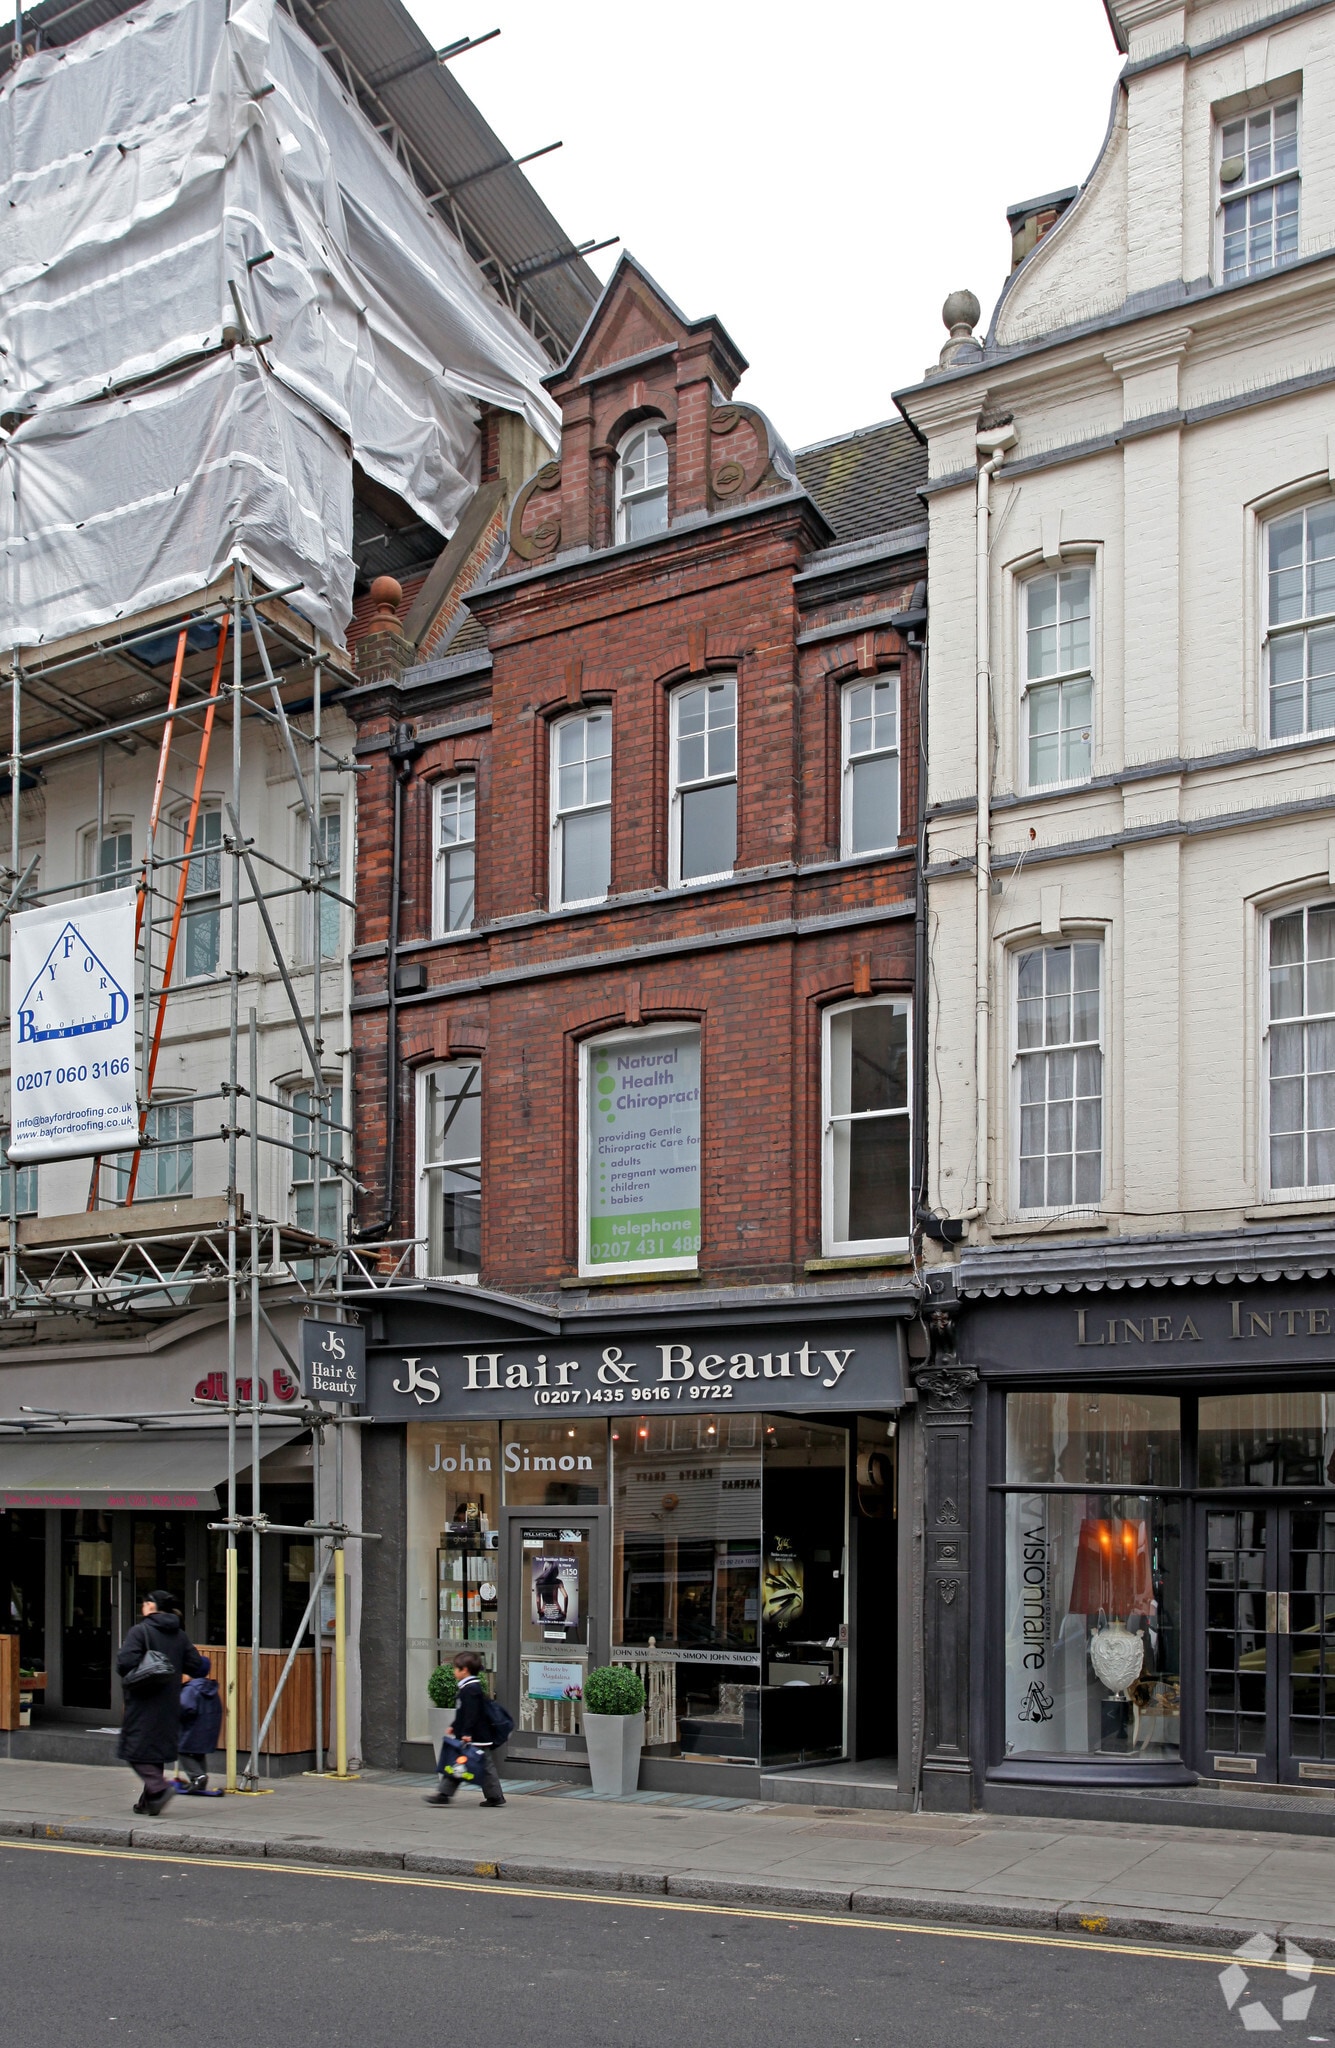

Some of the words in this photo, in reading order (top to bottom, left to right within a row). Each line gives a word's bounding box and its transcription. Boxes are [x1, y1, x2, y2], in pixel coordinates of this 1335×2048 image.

[34, 1012, 109, 1031] ROOFING
[34, 1021, 109, 1041] LIMITED
[617, 1048, 678, 1071] Natural
[16, 1070, 52, 1092] 0207
[56, 1065, 87, 1084] 060
[92, 1057, 130, 1079] 3166
[622, 1069, 674, 1090] Health
[616, 1087, 700, 1109] Chiropract
[16, 1102, 132, 1128] info@bayfordroofing.co.uk
[16, 1116, 132, 1140] www.bayfordroofing.co.uk
[598, 1130, 646, 1144] providing
[649, 1125, 682, 1137] Gentle
[598, 1141, 657, 1154] Chiropractic
[660, 1138, 684, 1148] Care
[686, 1135, 701, 1145] for
[611, 1157, 641, 1168] adults
[611, 1168, 656, 1182] pregnant
[659, 1165, 697, 1175] women
[611, 1182, 650, 1192] children
[611, 1194, 644, 1205] babies
[612, 1218, 692, 1237] telephone
[591, 1241, 631, 1259] 0207
[636, 1238, 664, 1255] 431
[1073, 1308, 1204, 1346] LINEA
[1227, 1300, 1331, 1338] INTE
[321, 1330, 346, 1360] JS
[311, 1361, 343, 1378] Hair
[346, 1365, 357, 1380] &
[392, 1357, 441, 1405] JS
[462, 1353, 579, 1390] Hair
[597, 1346, 639, 1385] &
[656, 1341, 855, 1388] Beauty
[272, 1368, 299, 1402] t
[311, 1375, 357, 1397] Beauty
[631, 1386, 670, 1401] 9616
[677, 1385, 683, 1399] /
[689, 1384, 733, 1399] 9722
[428, 1444, 491, 1472] John
[504, 1443, 593, 1472] Simon
[562, 1568, 578, 1576] £150
[1023, 1526, 1050, 1670] visionnaire
[683, 1652, 708, 1660] SIMON
[709, 1653, 730, 1661] JOHN
[732, 1655, 758, 1663] SIMON
